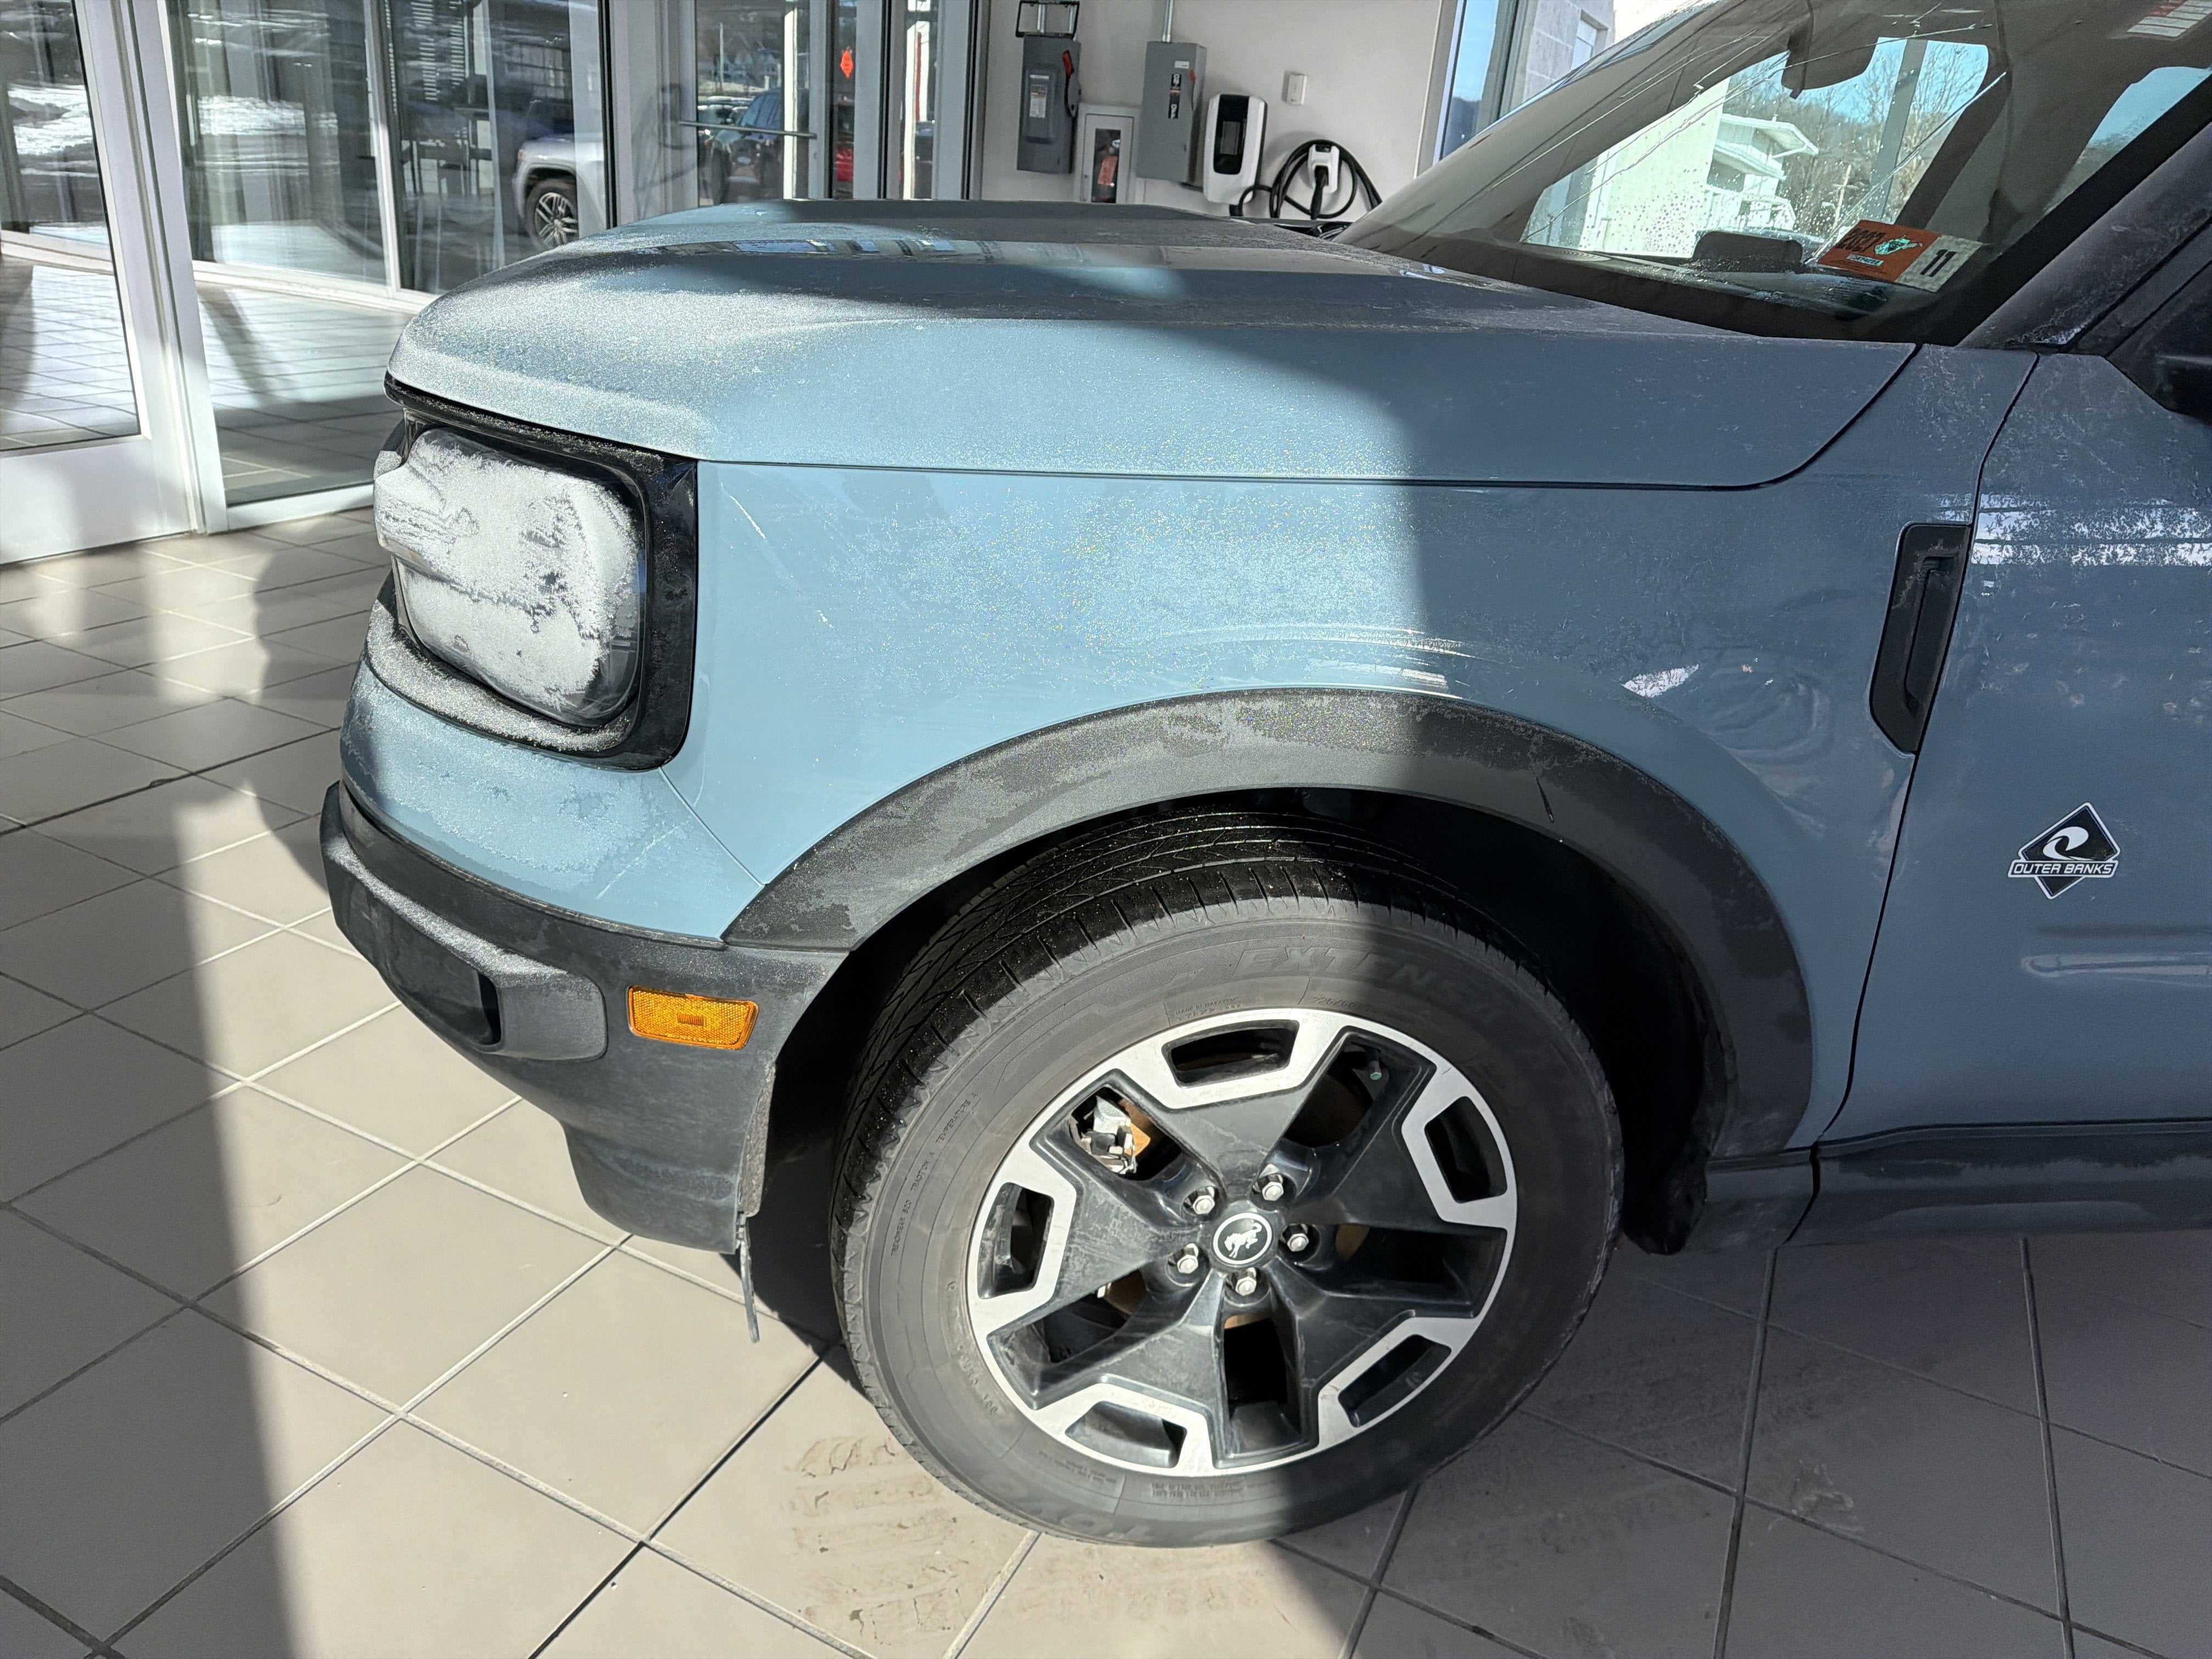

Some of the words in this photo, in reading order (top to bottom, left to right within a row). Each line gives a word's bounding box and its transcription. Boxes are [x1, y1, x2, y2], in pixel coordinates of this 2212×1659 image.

[1920, 249, 1958, 278] 11
[2013, 863, 2060, 874] OUTER
[2064, 863, 2114, 874] BANKS
